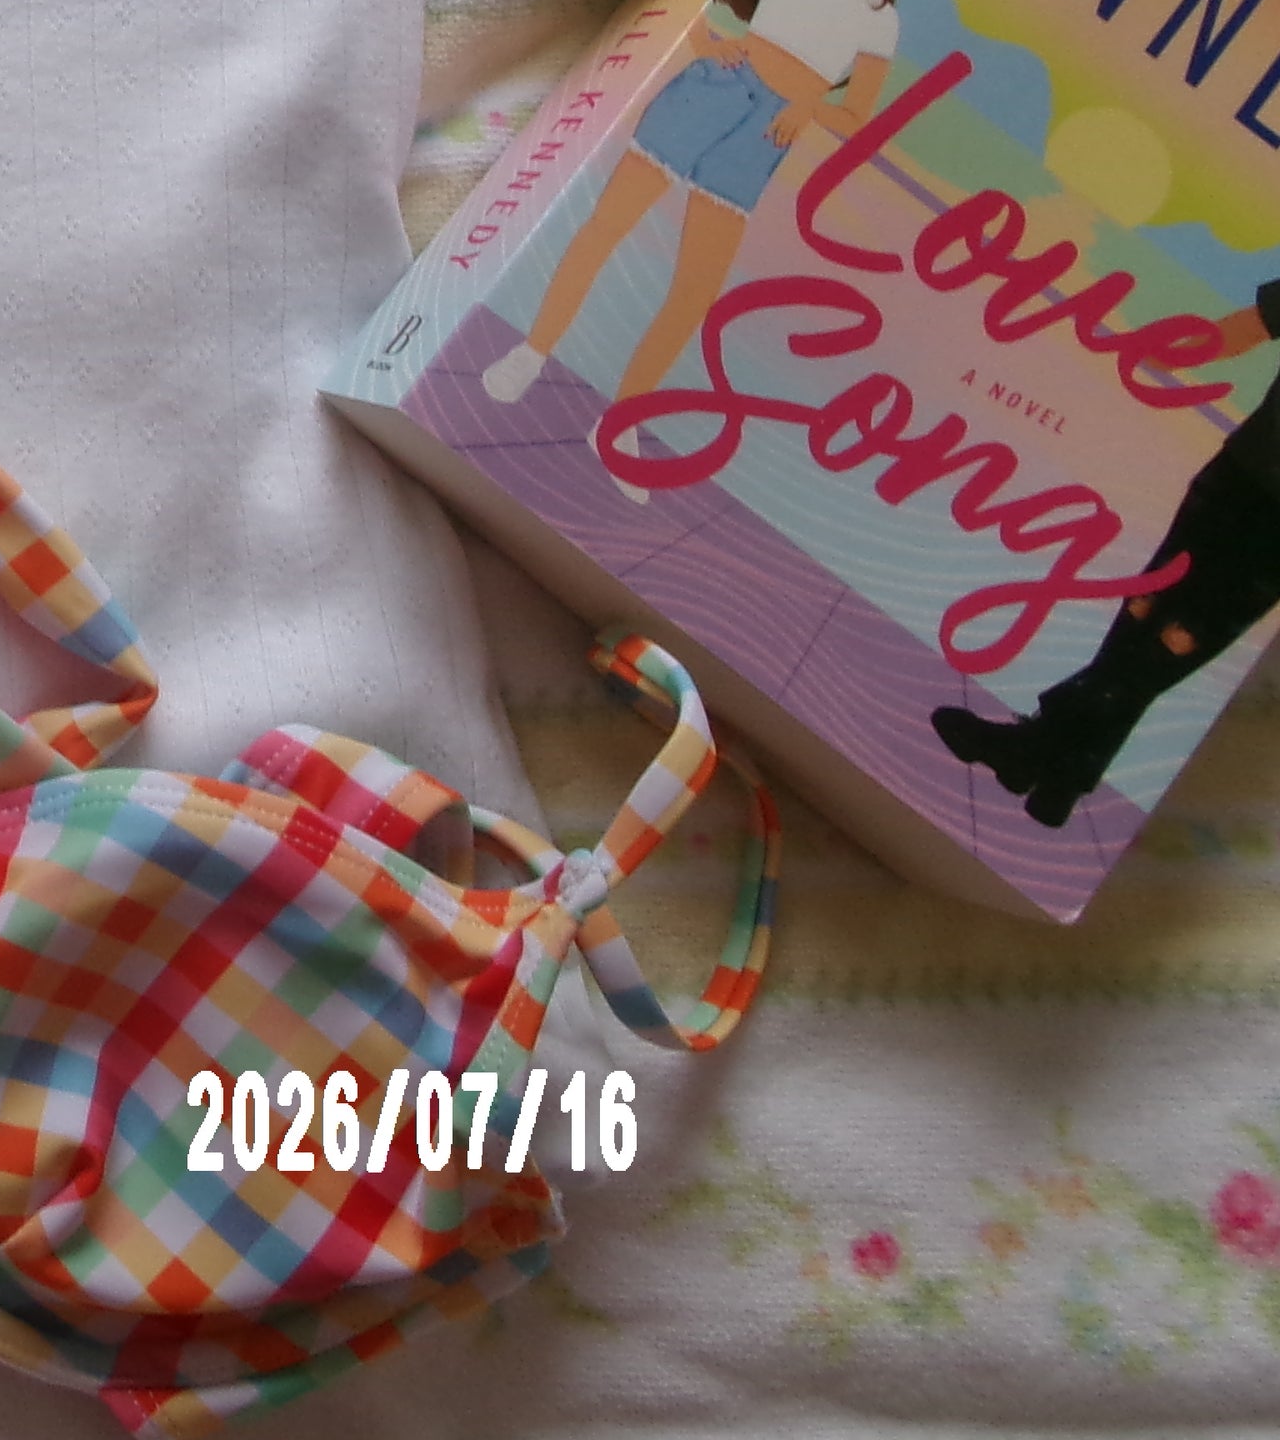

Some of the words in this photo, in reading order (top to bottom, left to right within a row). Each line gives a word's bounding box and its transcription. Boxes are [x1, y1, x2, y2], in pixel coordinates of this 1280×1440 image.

[449, 90, 604, 271] KENNEDY
[795, 50, 1235, 411] Love
[382, 314, 423, 356] B
[960, 368, 977, 386] A
[988, 381, 1066, 435] NOVEL
[594, 274, 1192, 675] Song
